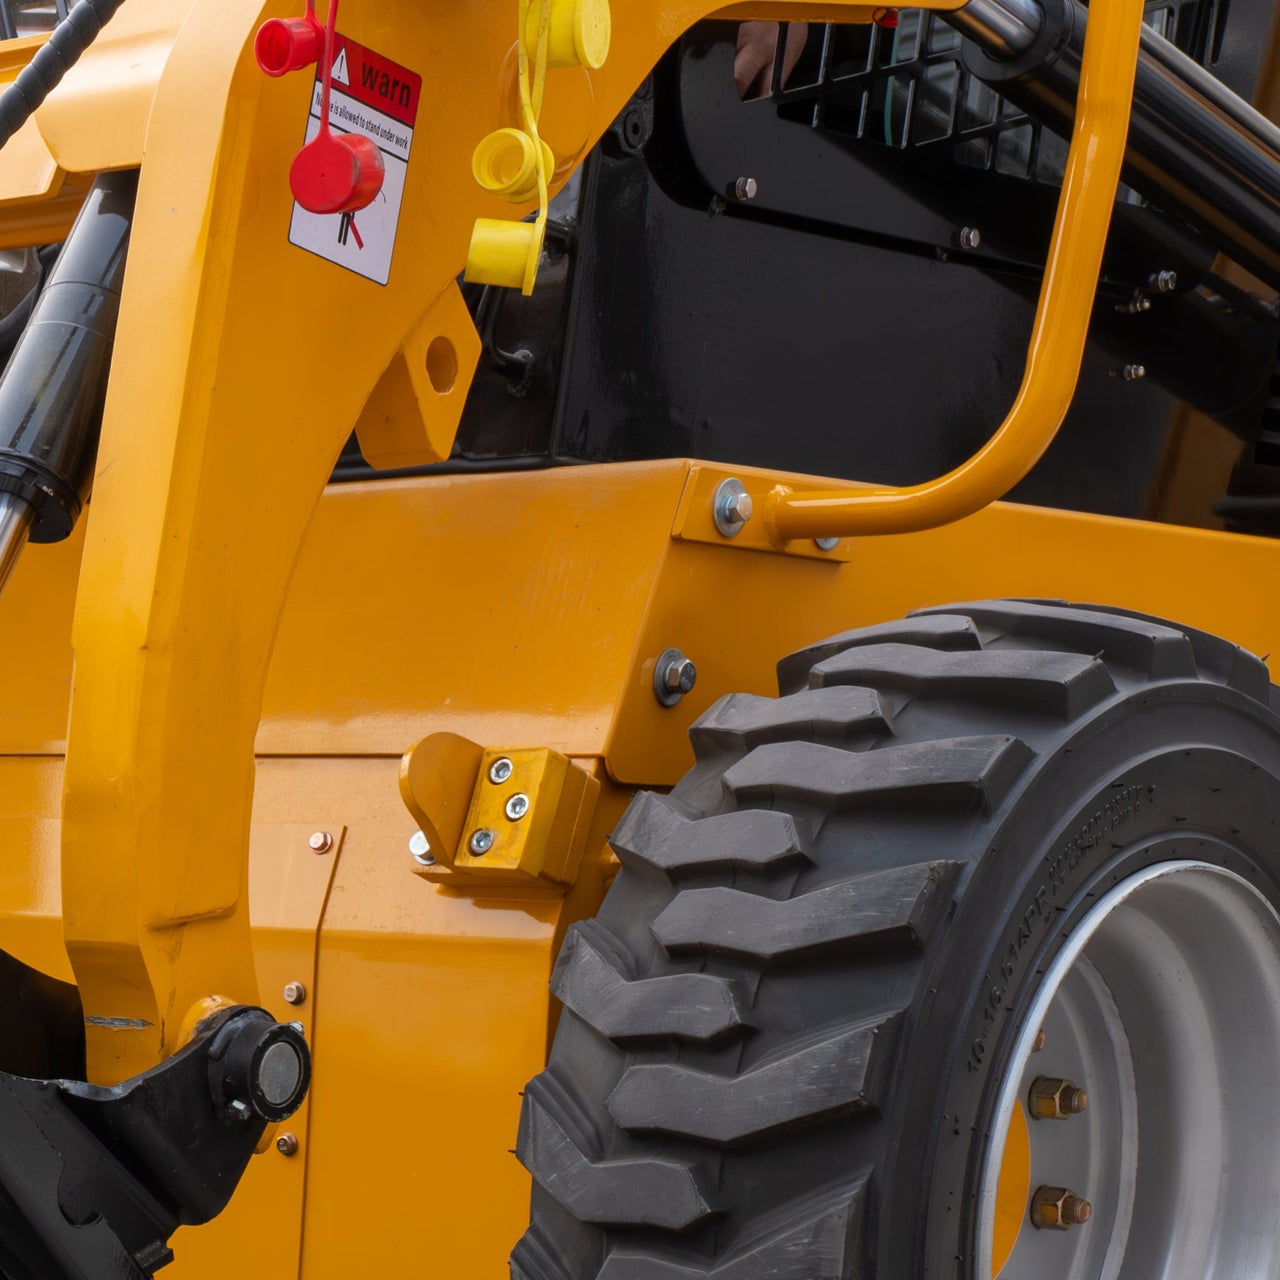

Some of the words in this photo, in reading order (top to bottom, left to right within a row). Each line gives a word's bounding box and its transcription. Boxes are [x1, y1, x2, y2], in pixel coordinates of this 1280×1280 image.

[339, 105, 360, 126] allowed
[359, 115, 365, 128] to
[365, 119, 381, 136] stand
[380, 127, 395, 143] under
[394, 136, 408, 149] work
